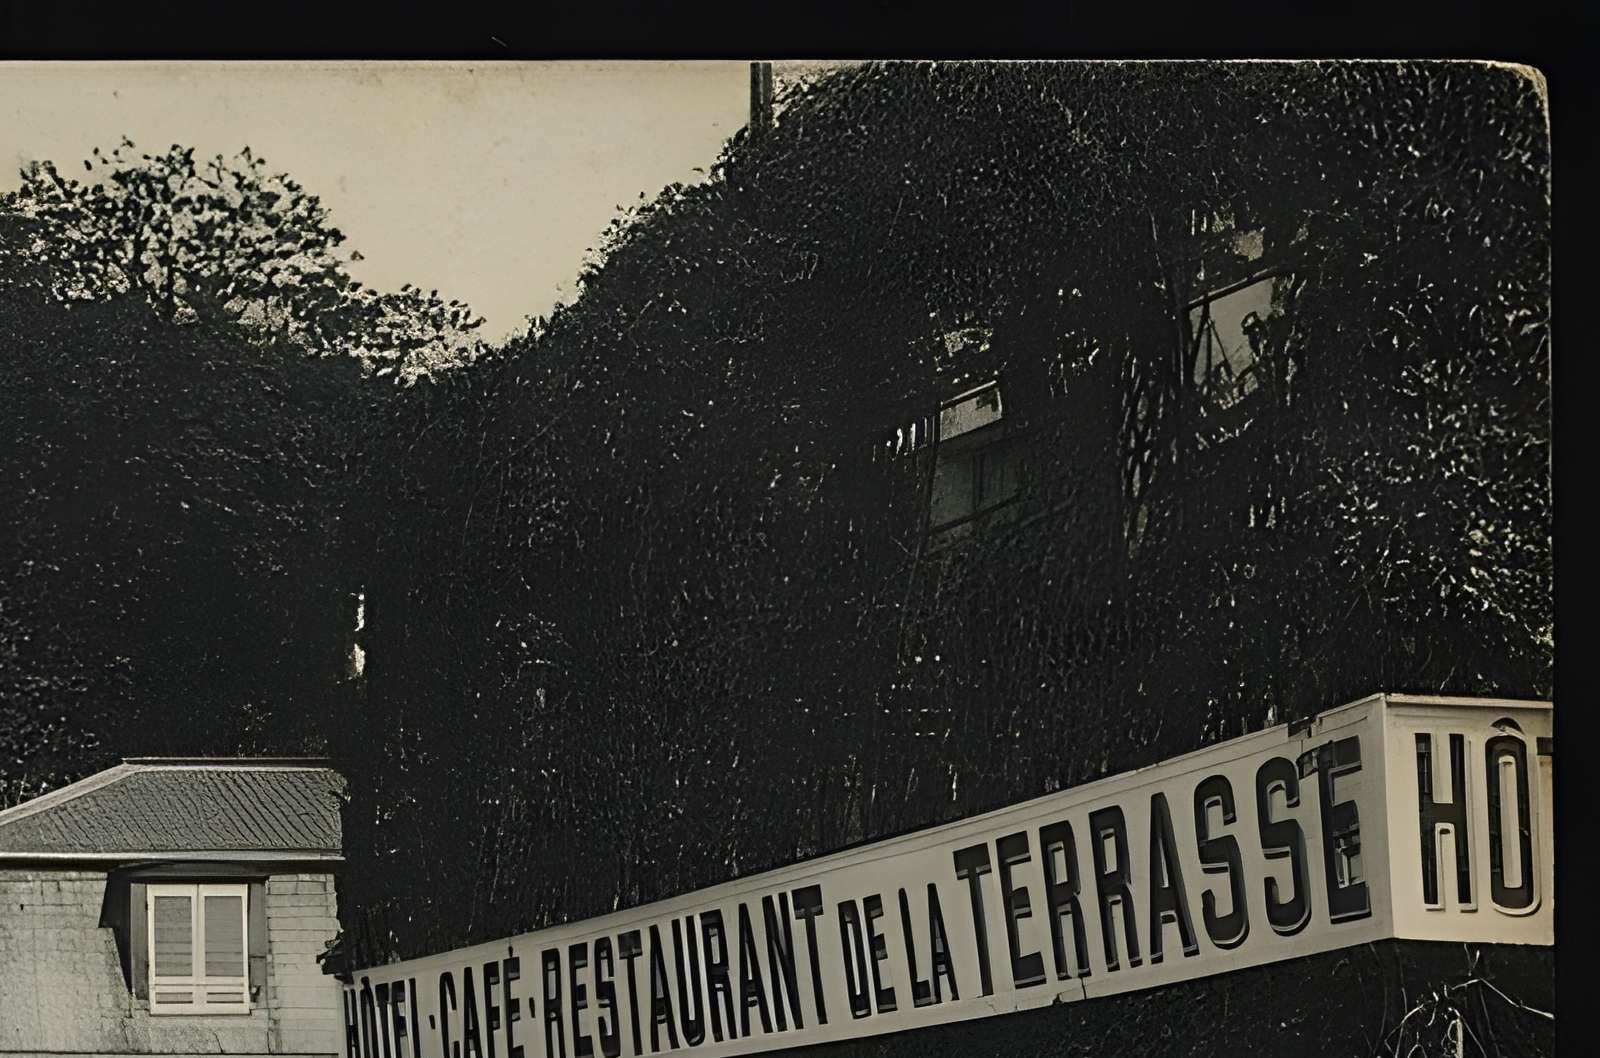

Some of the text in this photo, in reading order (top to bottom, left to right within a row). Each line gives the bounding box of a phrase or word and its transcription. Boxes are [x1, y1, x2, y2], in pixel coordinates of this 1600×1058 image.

[837, 894, 898, 1019] DE
[899, 882, 960, 1008] LA
[953, 735, 1371, 996] TERRASSE
[1414, 717, 1553, 916] HÔ
